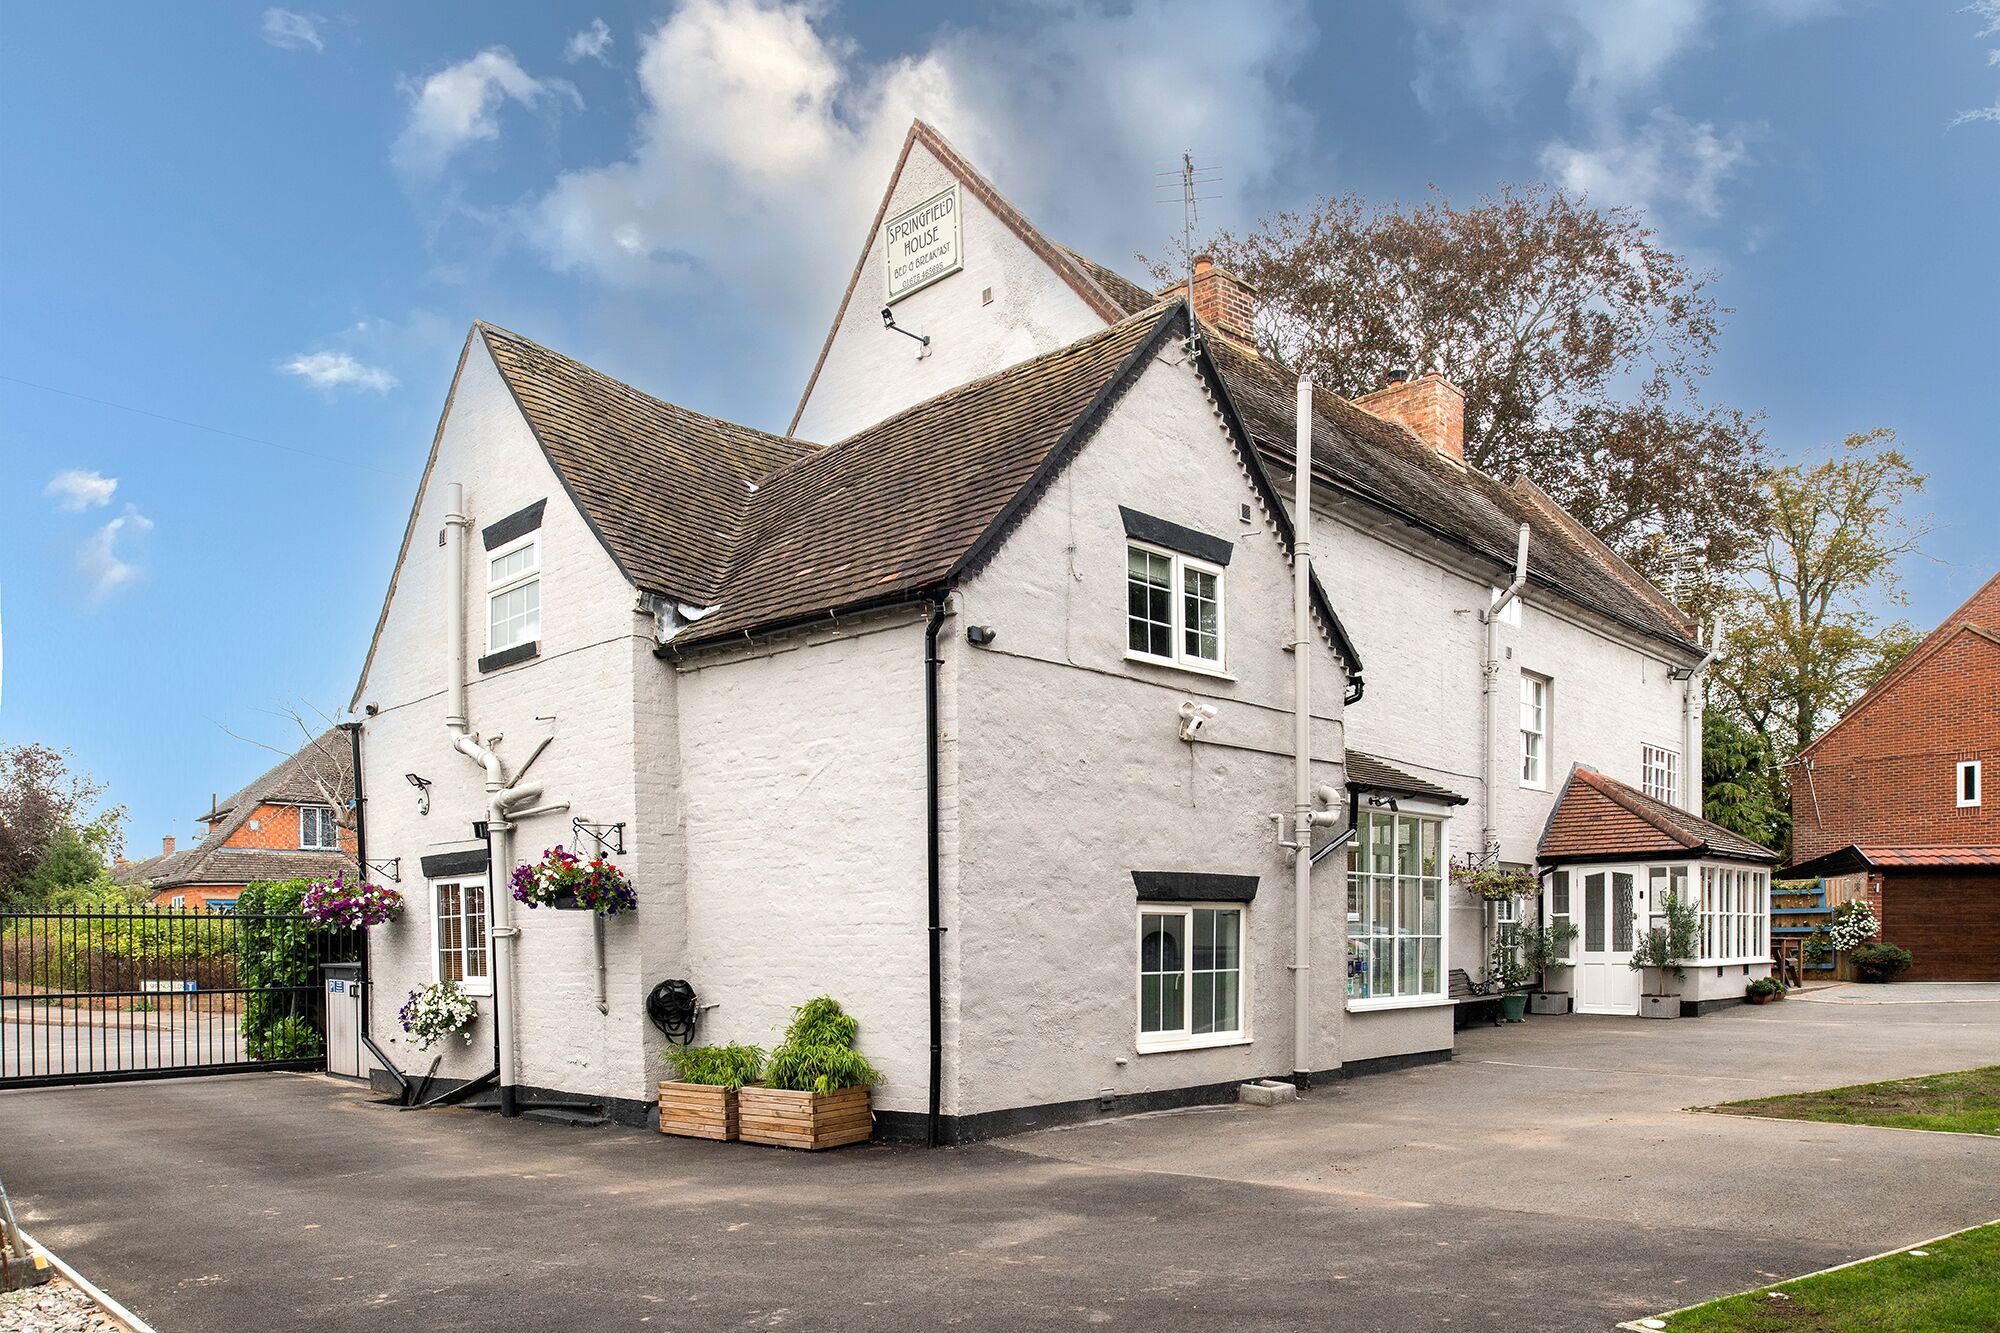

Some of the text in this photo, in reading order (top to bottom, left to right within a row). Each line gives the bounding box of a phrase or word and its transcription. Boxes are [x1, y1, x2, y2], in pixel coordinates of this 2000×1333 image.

[889, 198, 953, 244] SPRINGFIELD
[894, 264, 907, 279] BED
[915, 241, 951, 269] BREAKFAST
[904, 226, 940, 257] HOUSE
